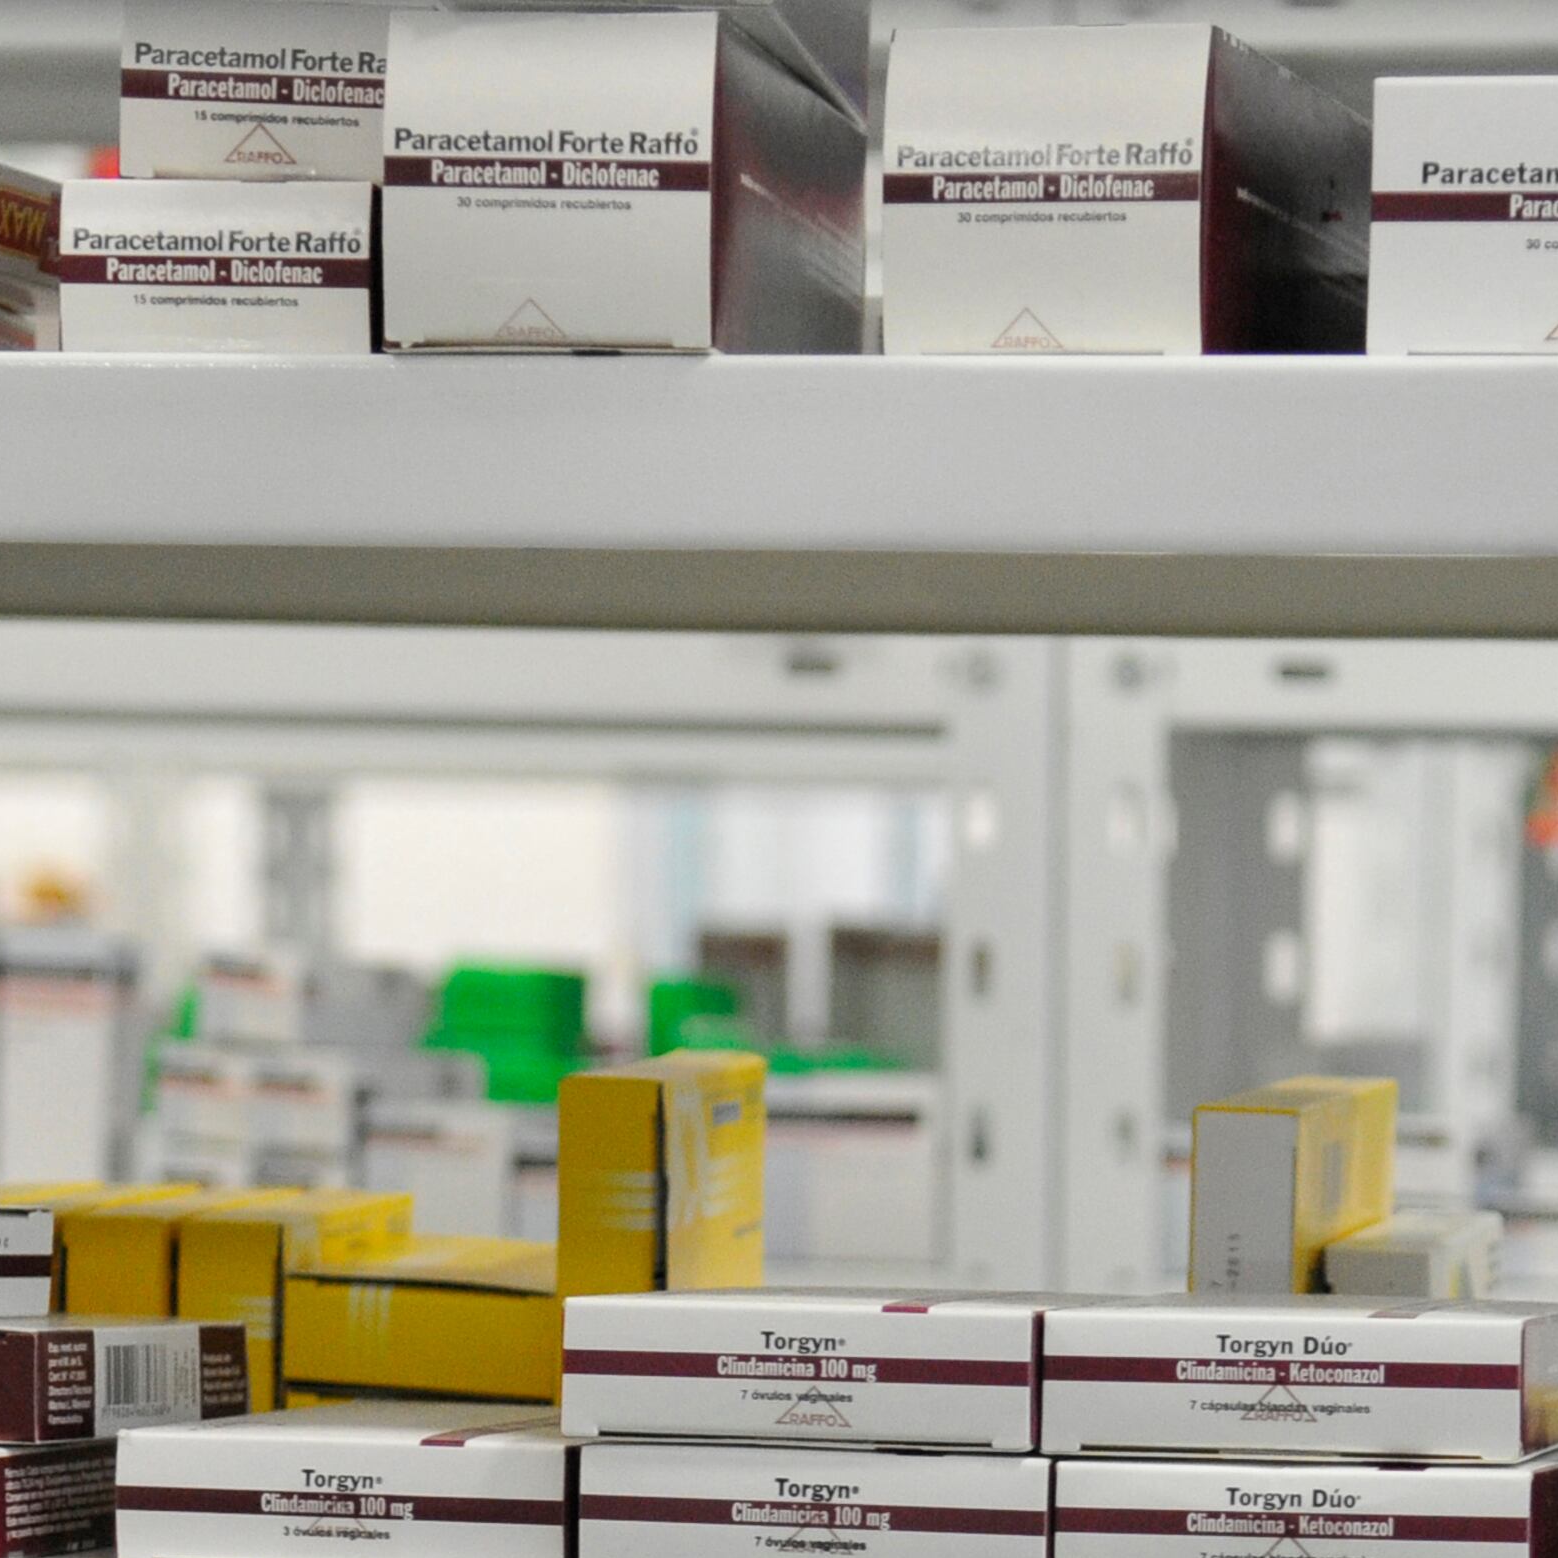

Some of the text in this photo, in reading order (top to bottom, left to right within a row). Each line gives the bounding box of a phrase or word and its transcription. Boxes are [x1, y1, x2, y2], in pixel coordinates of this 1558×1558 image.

[135, 43, 286, 70] Paracetamol
[291, 50, 354, 71] Forte
[395, 128, 553, 153] Paracetamol
[559, 132, 624, 154] Forte
[897, 143, 1051, 168] Paracetamol
[1056, 143, 1120, 166] Forte
[432, 162, 659, 187] Paracetamol Diclofenac
[975, 212, 1055, 225] comprimidos
[1058, 211, 1127, 223] recubiertos
[73, 227, 223, 253] Paracetamol
[229, 231, 291, 253] Forte
[1526, 239, 1541, 250] 30
[1217, 1335, 1294, 1358] Torgyn
[717, 1356, 876, 1383] Clindamicina 100 mg
[1176, 1360, 1385, 1386] Clindamicina Ketoconazol
[740, 1390, 747, 1400] 7
[1226, 1488, 1302, 1511] Torgyn
